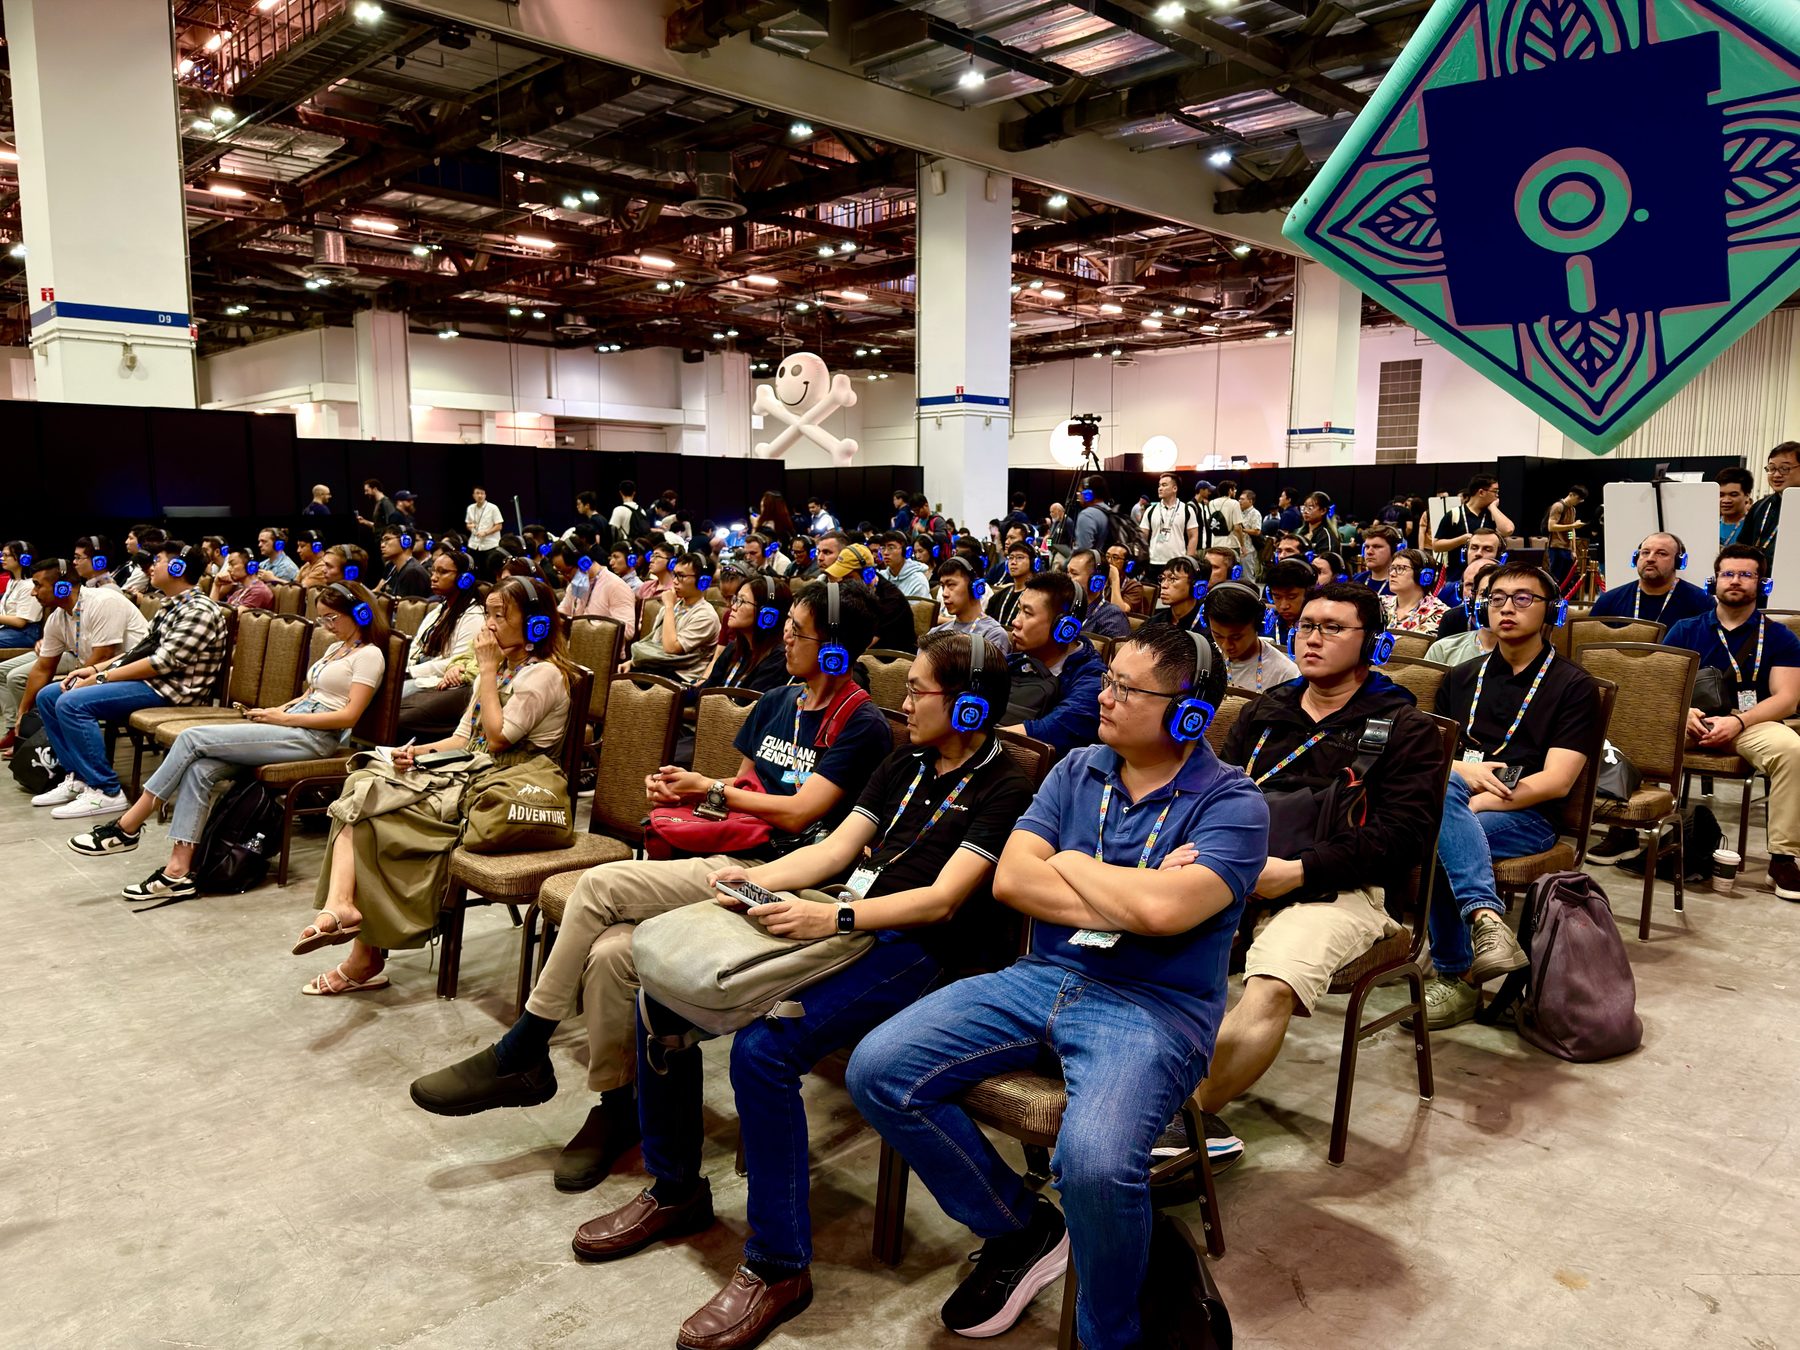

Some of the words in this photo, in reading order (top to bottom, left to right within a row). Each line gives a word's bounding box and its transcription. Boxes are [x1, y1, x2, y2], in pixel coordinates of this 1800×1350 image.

[158, 313, 172, 324] D9
[761, 747, 814, 773] ENDPNT
[762, 734, 817, 763] GUARAN
[507, 803, 567, 826] ADVENTURE
